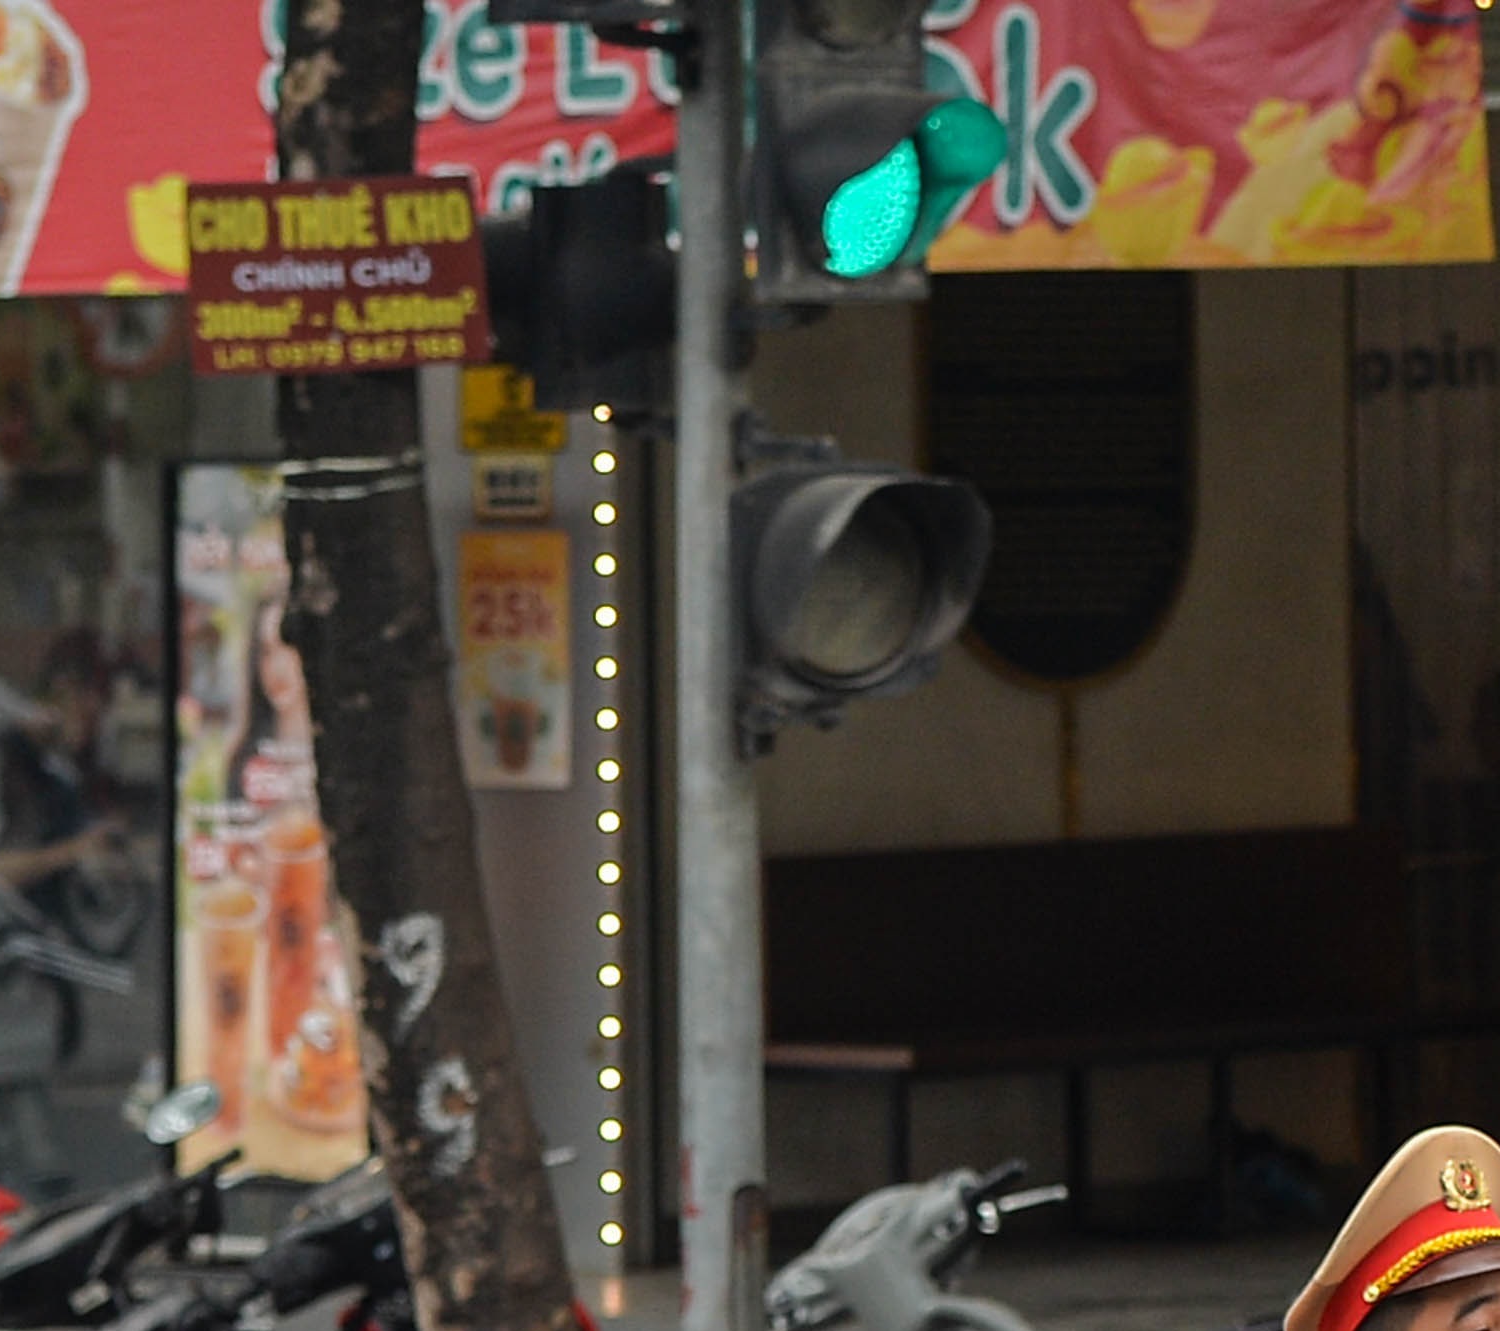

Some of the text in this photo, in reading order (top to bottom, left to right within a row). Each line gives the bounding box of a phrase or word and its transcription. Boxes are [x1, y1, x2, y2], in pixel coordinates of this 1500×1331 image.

[189, 185, 472, 252] CHO THUÊ KHO
